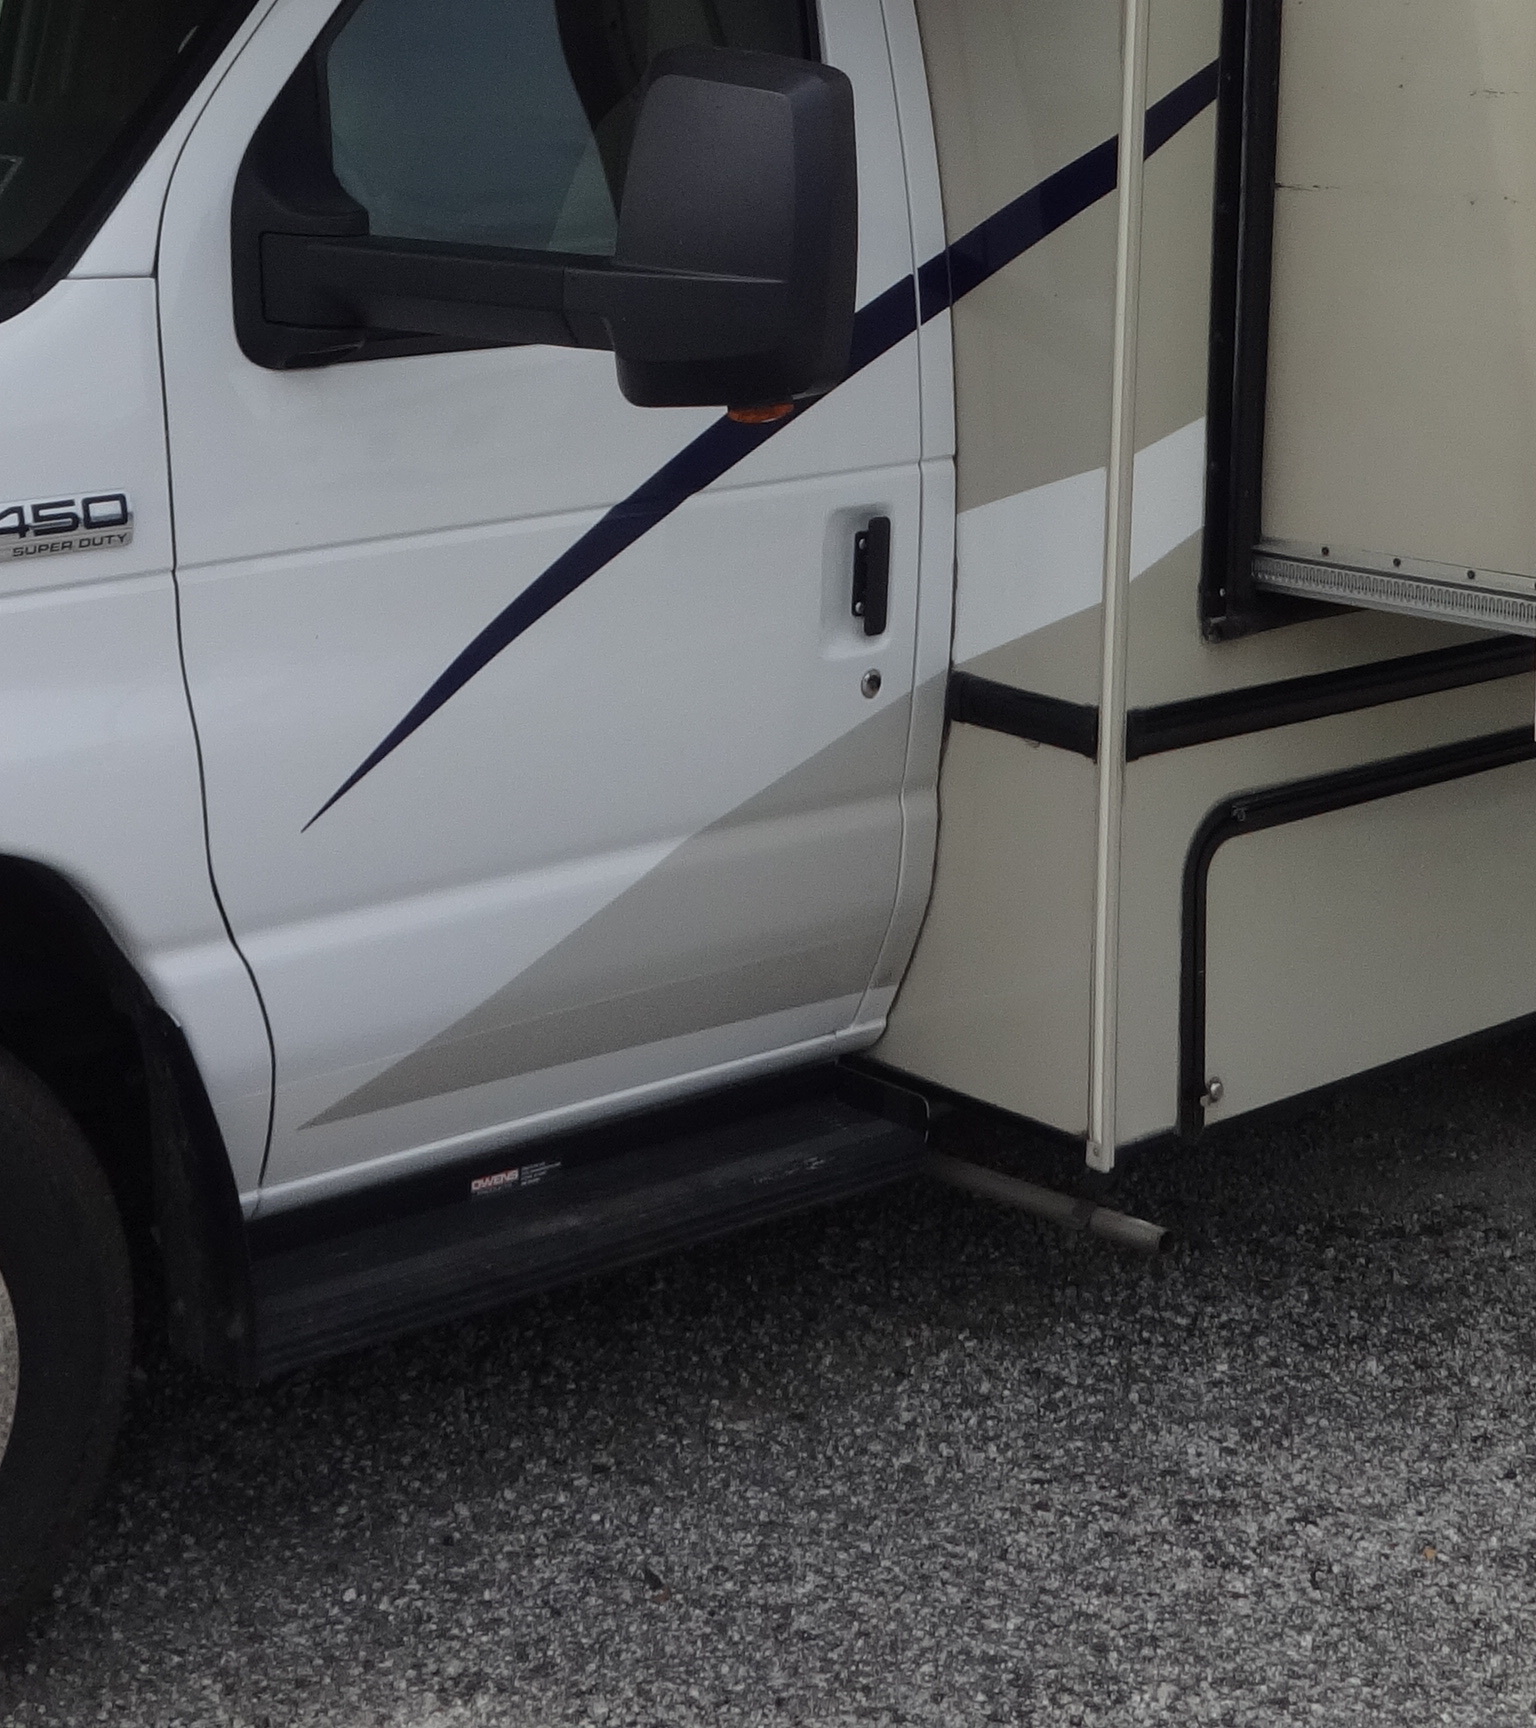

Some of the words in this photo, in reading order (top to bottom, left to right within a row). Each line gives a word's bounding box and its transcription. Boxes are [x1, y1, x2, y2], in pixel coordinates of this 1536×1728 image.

[12, 540, 72, 557] SUPER
[79, 533, 128, 548] DUTY
[471, 1168, 519, 1191] OWENS
